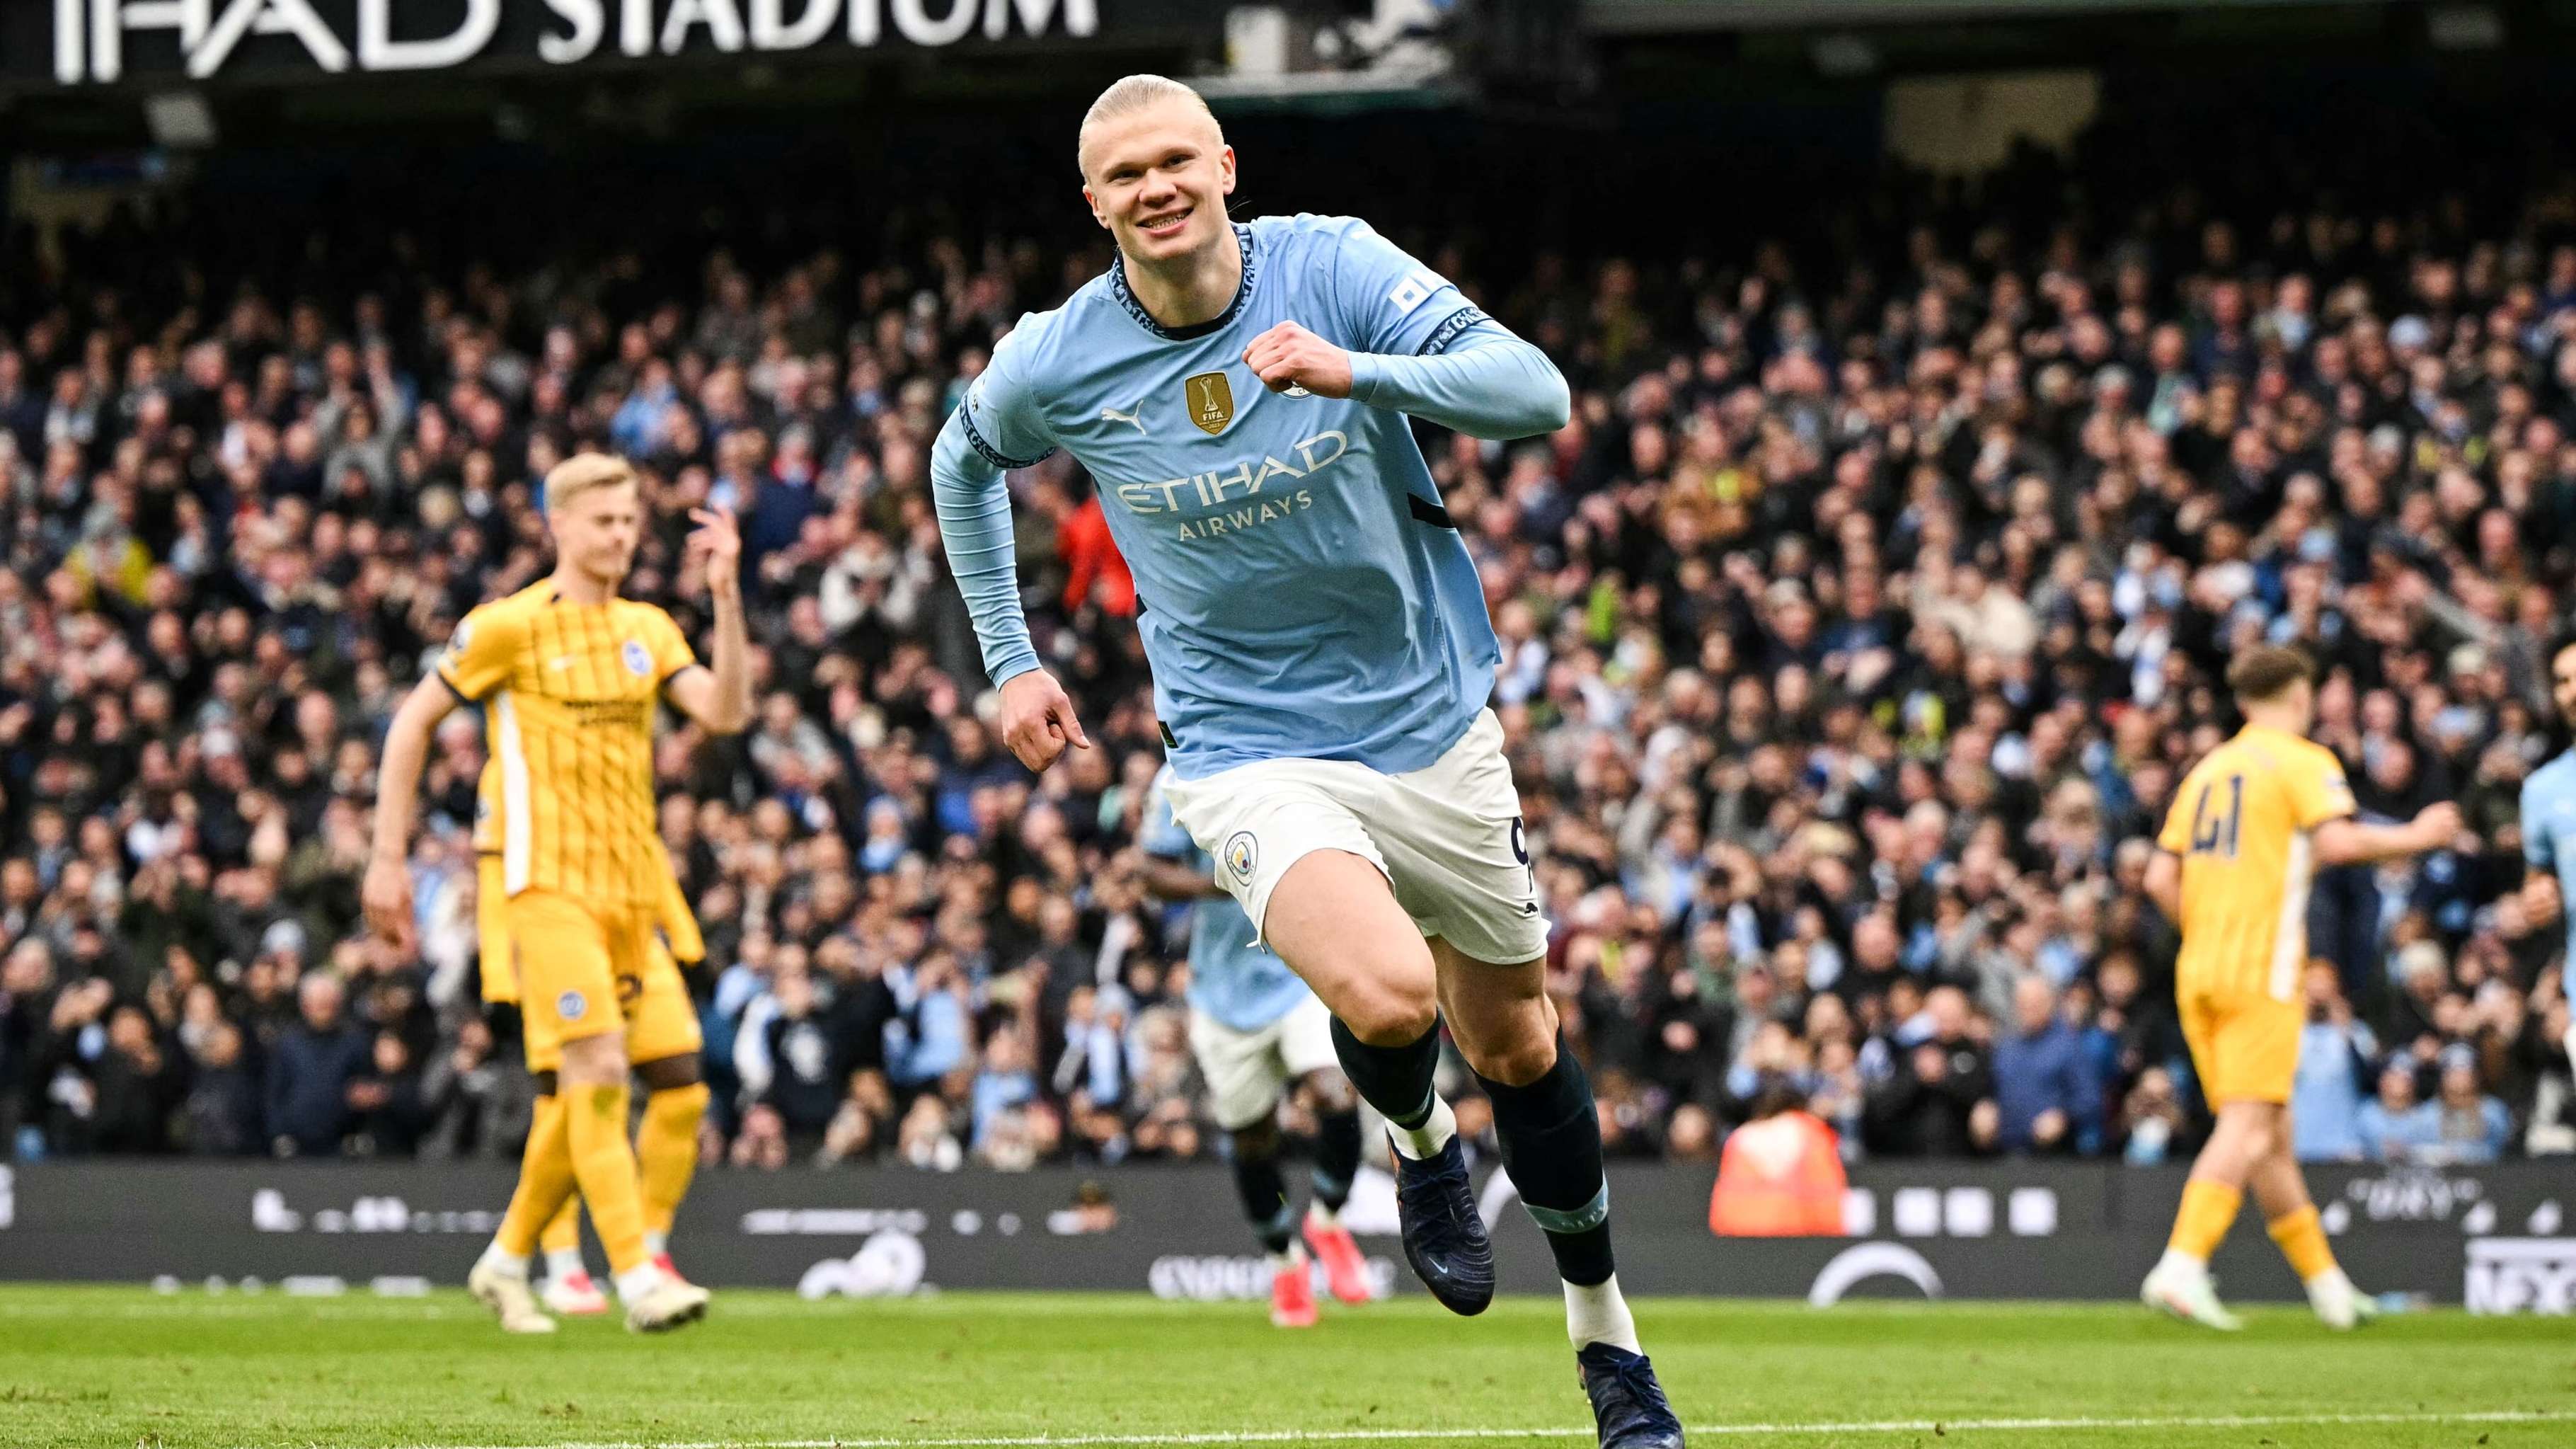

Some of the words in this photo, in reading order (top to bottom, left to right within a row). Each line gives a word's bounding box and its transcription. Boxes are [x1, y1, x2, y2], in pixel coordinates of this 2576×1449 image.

[1202, 411, 1224, 421] FIFA
[1117, 430, 1347, 513] ETIHAD
[1178, 490, 1313, 542] AIRWAYS
